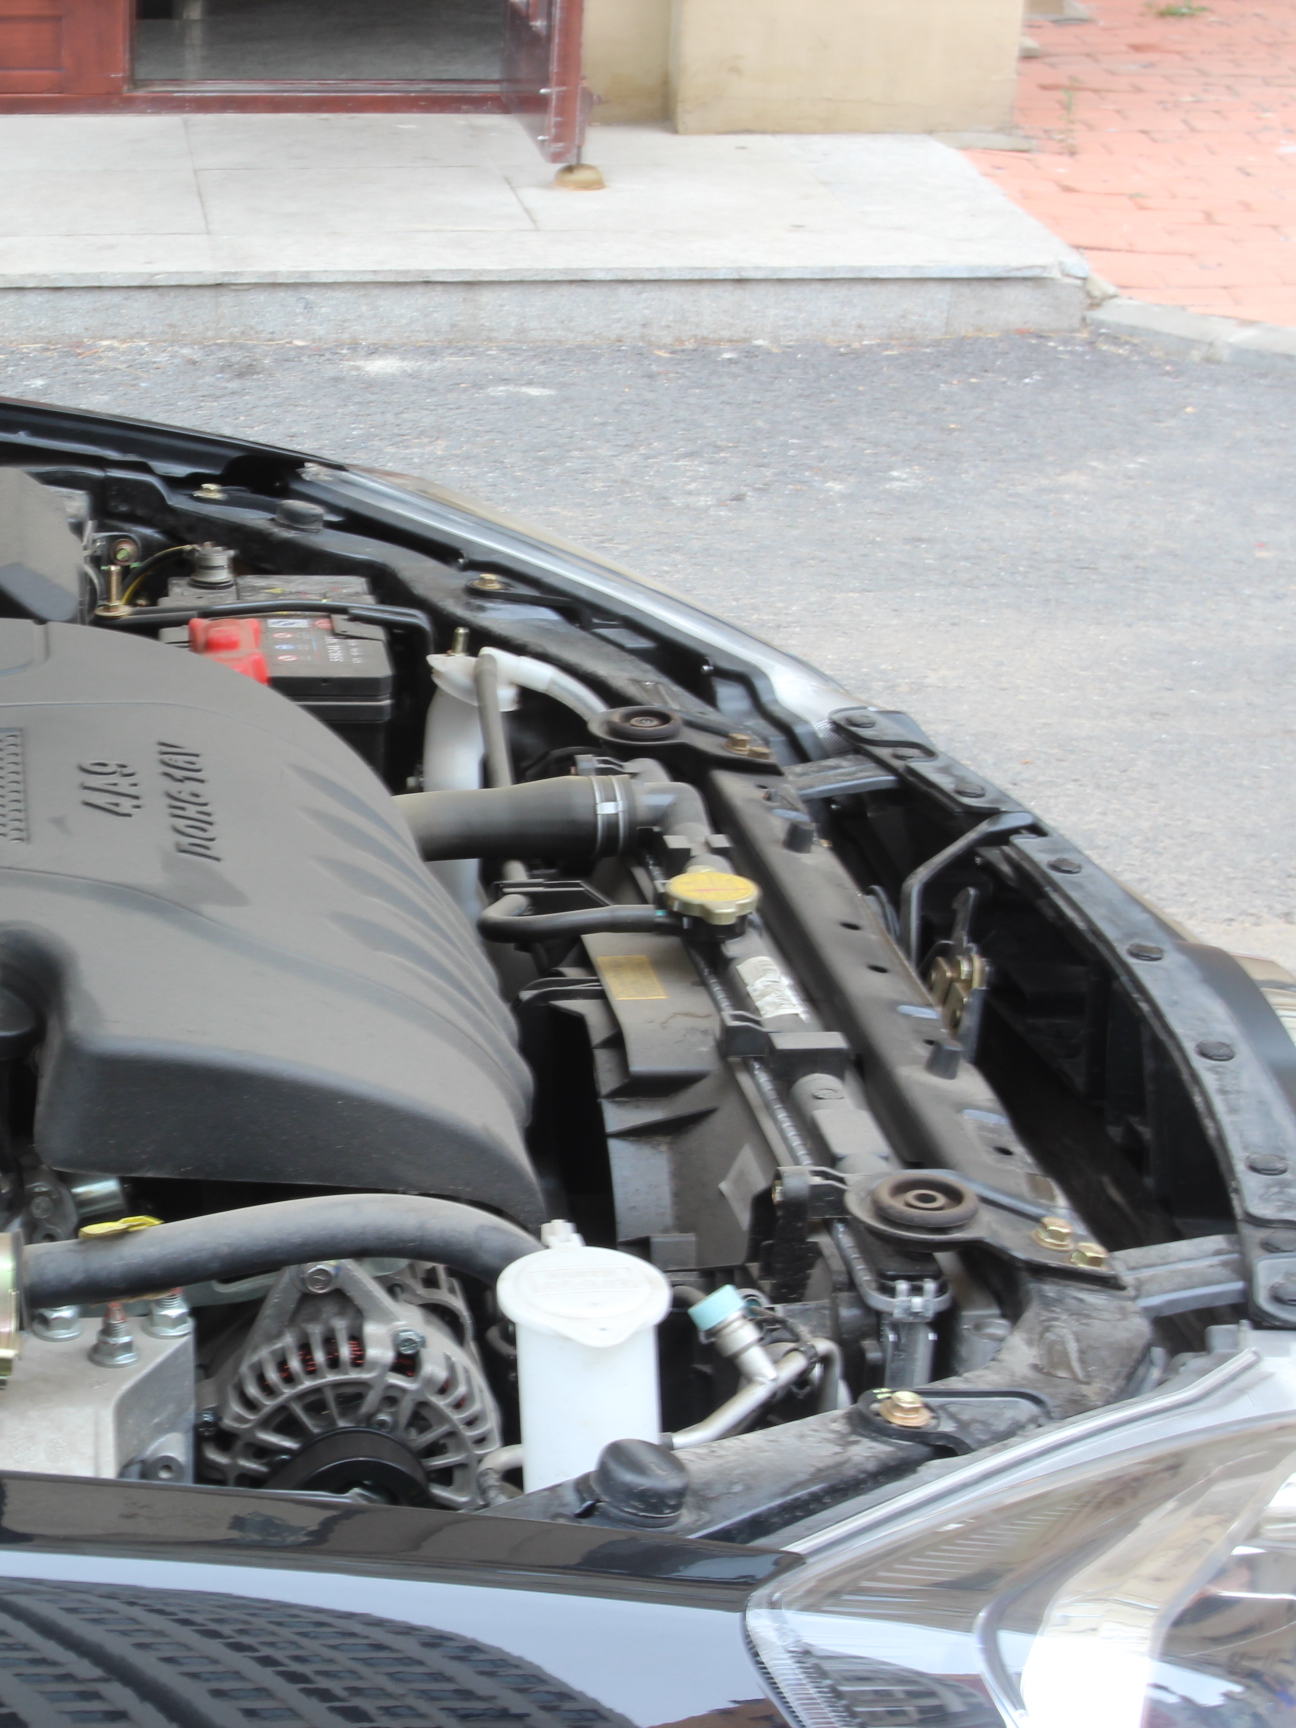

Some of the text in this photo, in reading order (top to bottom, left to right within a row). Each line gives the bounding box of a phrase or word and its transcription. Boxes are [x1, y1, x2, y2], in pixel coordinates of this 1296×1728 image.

[78, 756, 142, 818] 4A9
[156, 736, 222, 862] DOHC 16V
